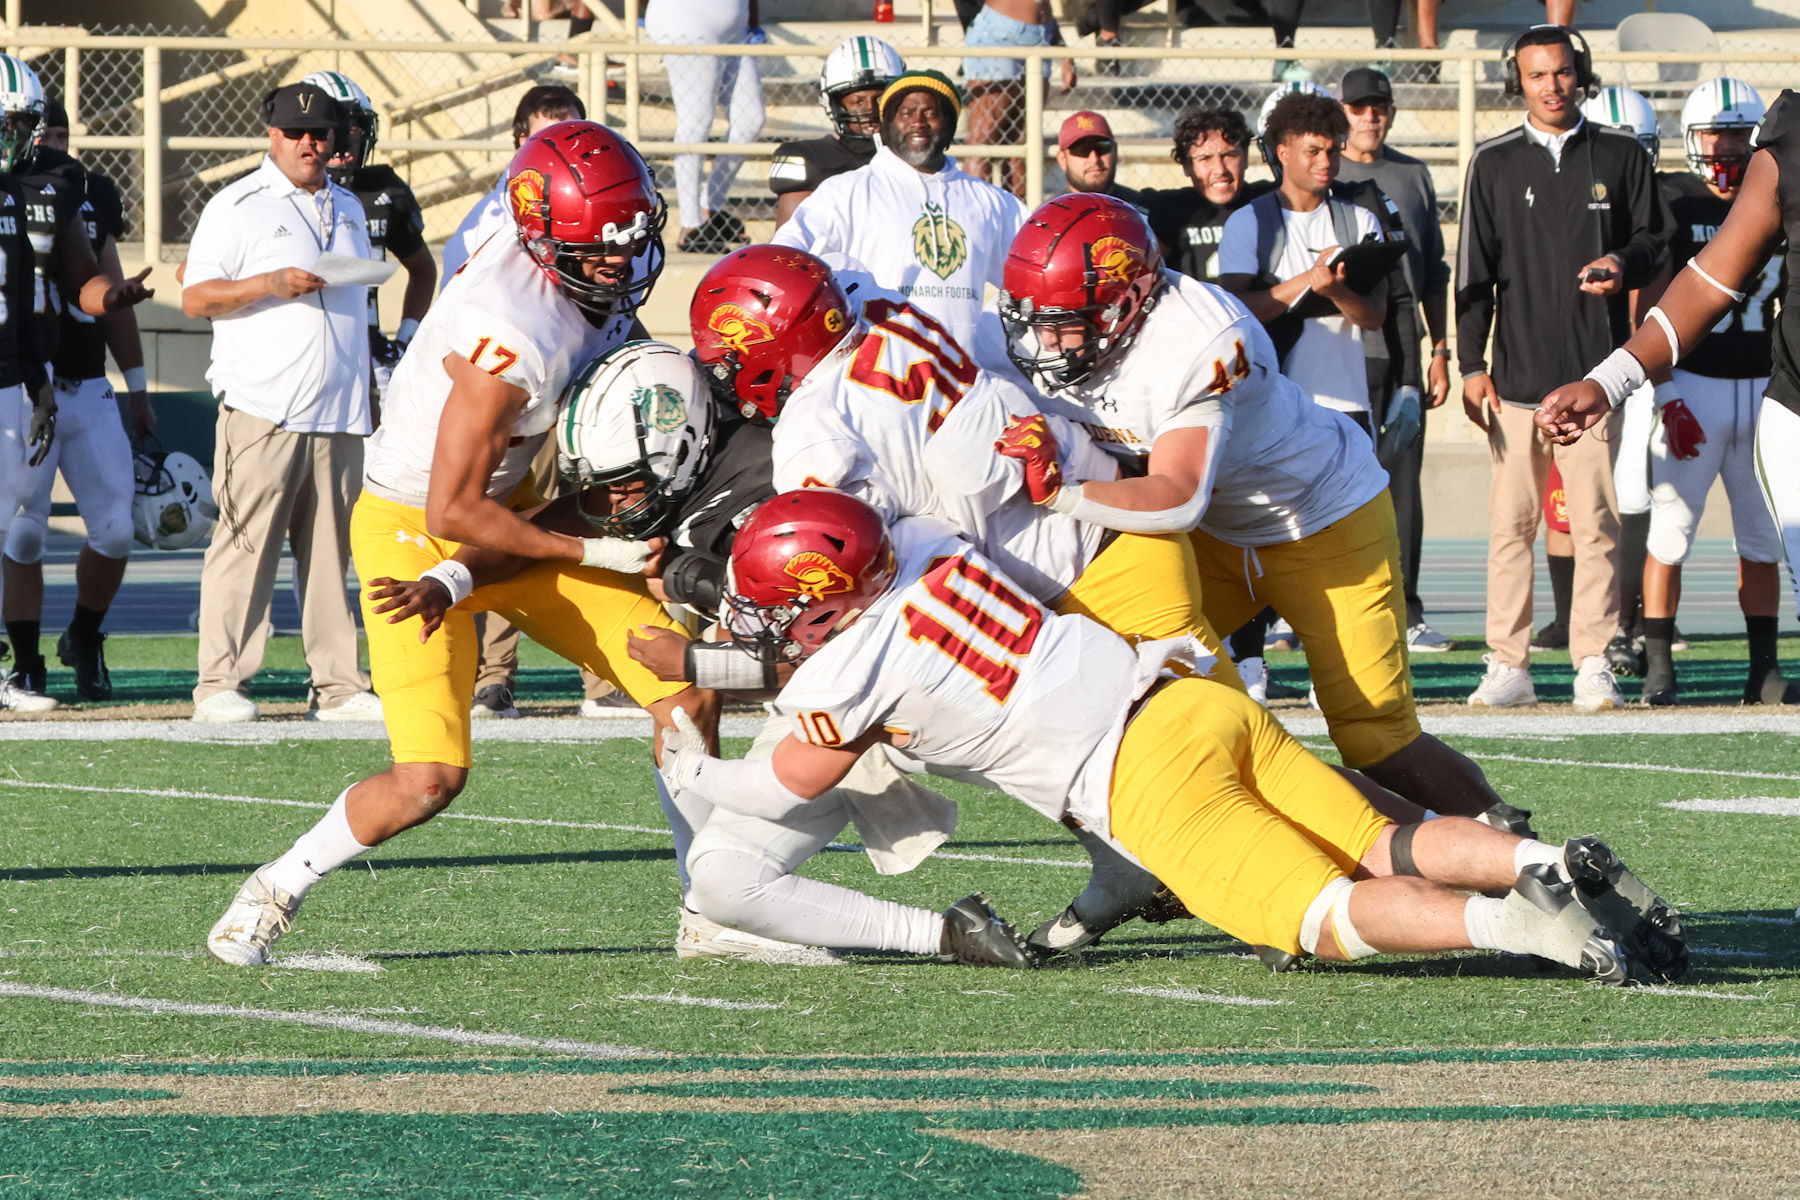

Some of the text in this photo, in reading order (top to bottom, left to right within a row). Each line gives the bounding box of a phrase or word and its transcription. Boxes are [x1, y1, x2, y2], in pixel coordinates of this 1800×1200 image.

[298, 92, 314, 114] V
[365, 218, 389, 237] HS
[898, 285, 943, 299] MONARCH
[468, 336, 519, 378] 17
[845, 298, 980, 435] 50
[1208, 338, 1251, 395] 44
[900, 554, 1043, 707] 10
[796, 710, 844, 747] 10
